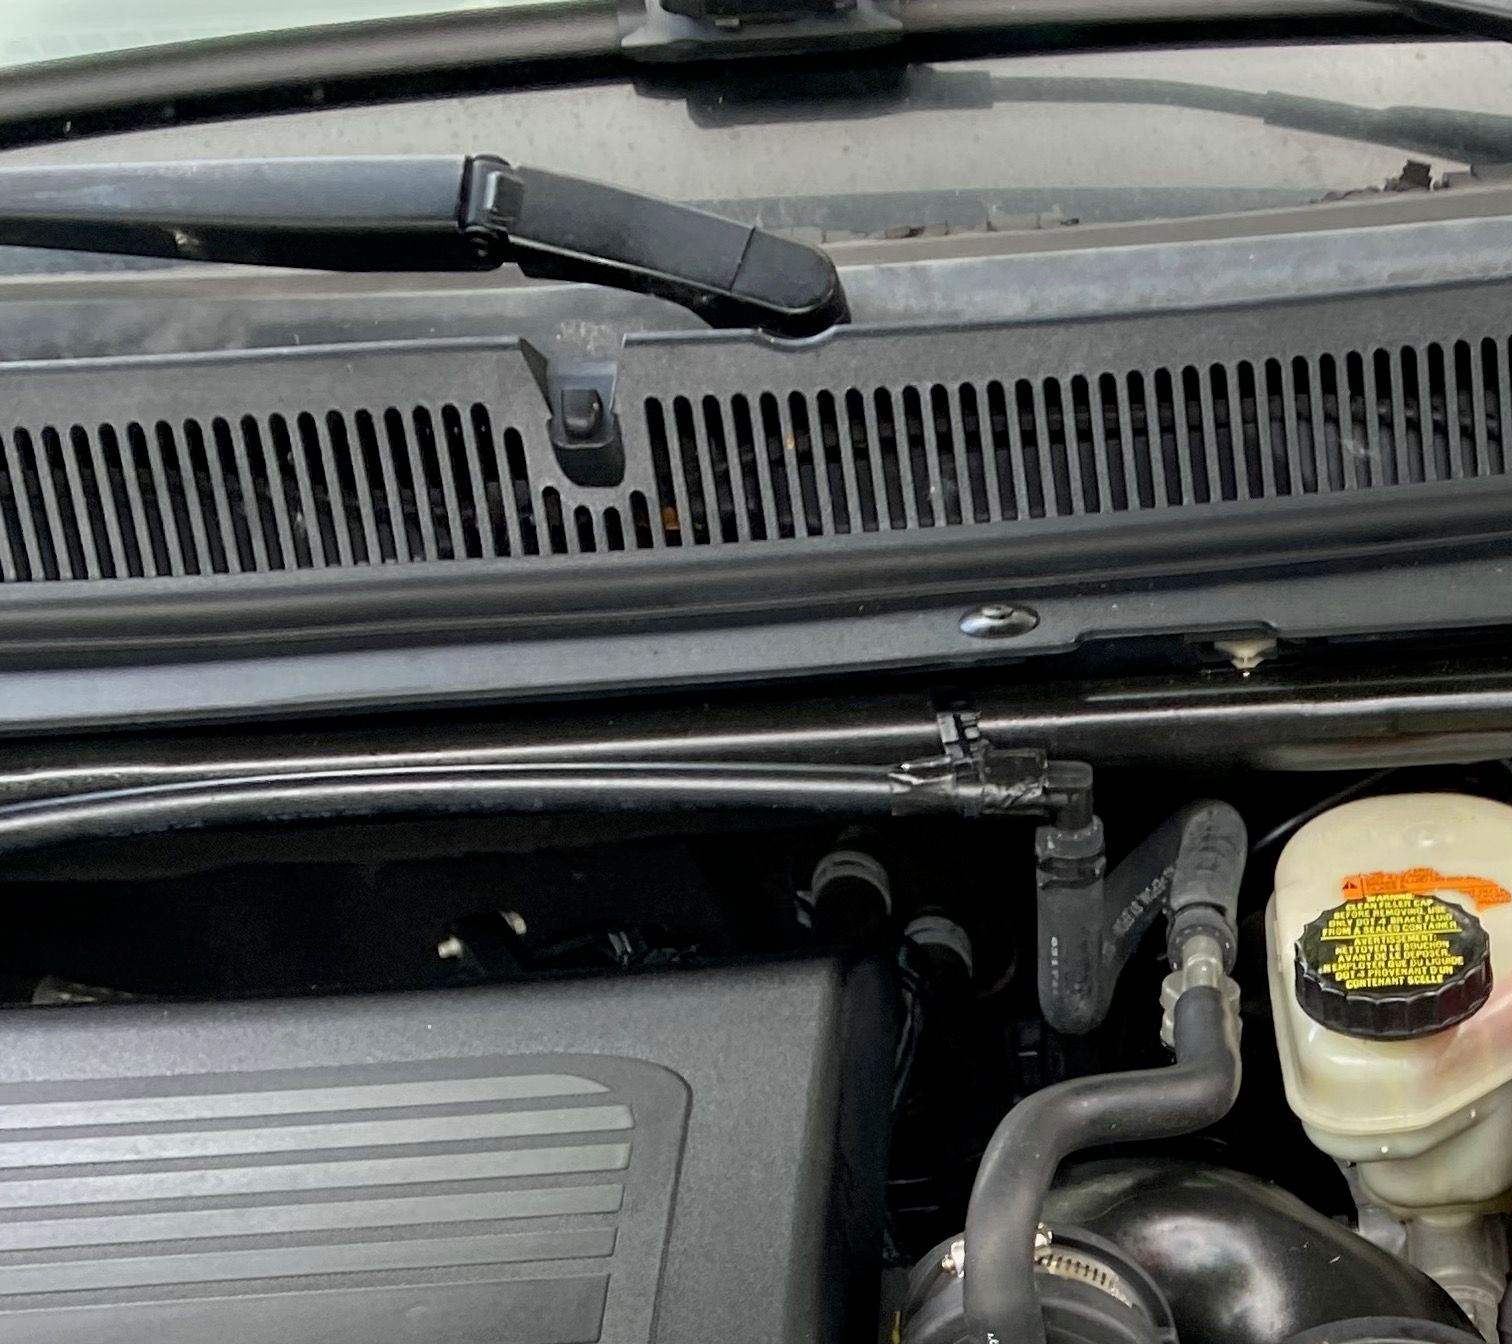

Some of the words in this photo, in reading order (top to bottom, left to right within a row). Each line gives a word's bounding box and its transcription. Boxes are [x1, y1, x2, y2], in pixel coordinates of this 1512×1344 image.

[1346, 902, 1377, 911] CLEAN
[1379, 900, 1412, 908] FILLER
[1329, 919, 1353, 928] ONLY
[1356, 918, 1375, 926] DOT
[1390, 915, 1422, 924] BRAKE
[1425, 914, 1453, 922] FLUID
[1334, 911, 1370, 920] BEFORE
[1322, 928, 1351, 937] FROM
[1354, 927, 1361, 935] A
[1364, 925, 1400, 934] SEALED
[1335, 945, 1386, 955] NETTOYER
[1389, 944, 1400, 952] LE
[1403, 940, 1449, 950] BOUCHON
[1338, 954, 1371, 963] AVANT
[1375, 952, 1387, 960] DE
[1390, 951, 1401, 959] LE
[1425, 956, 1463, 966] LIQUIDE
[1335, 972, 1355, 981] DOT
[1368, 967, 1427, 977] PROVENANT
[1345, 977, 1404, 989] CONTENANT
